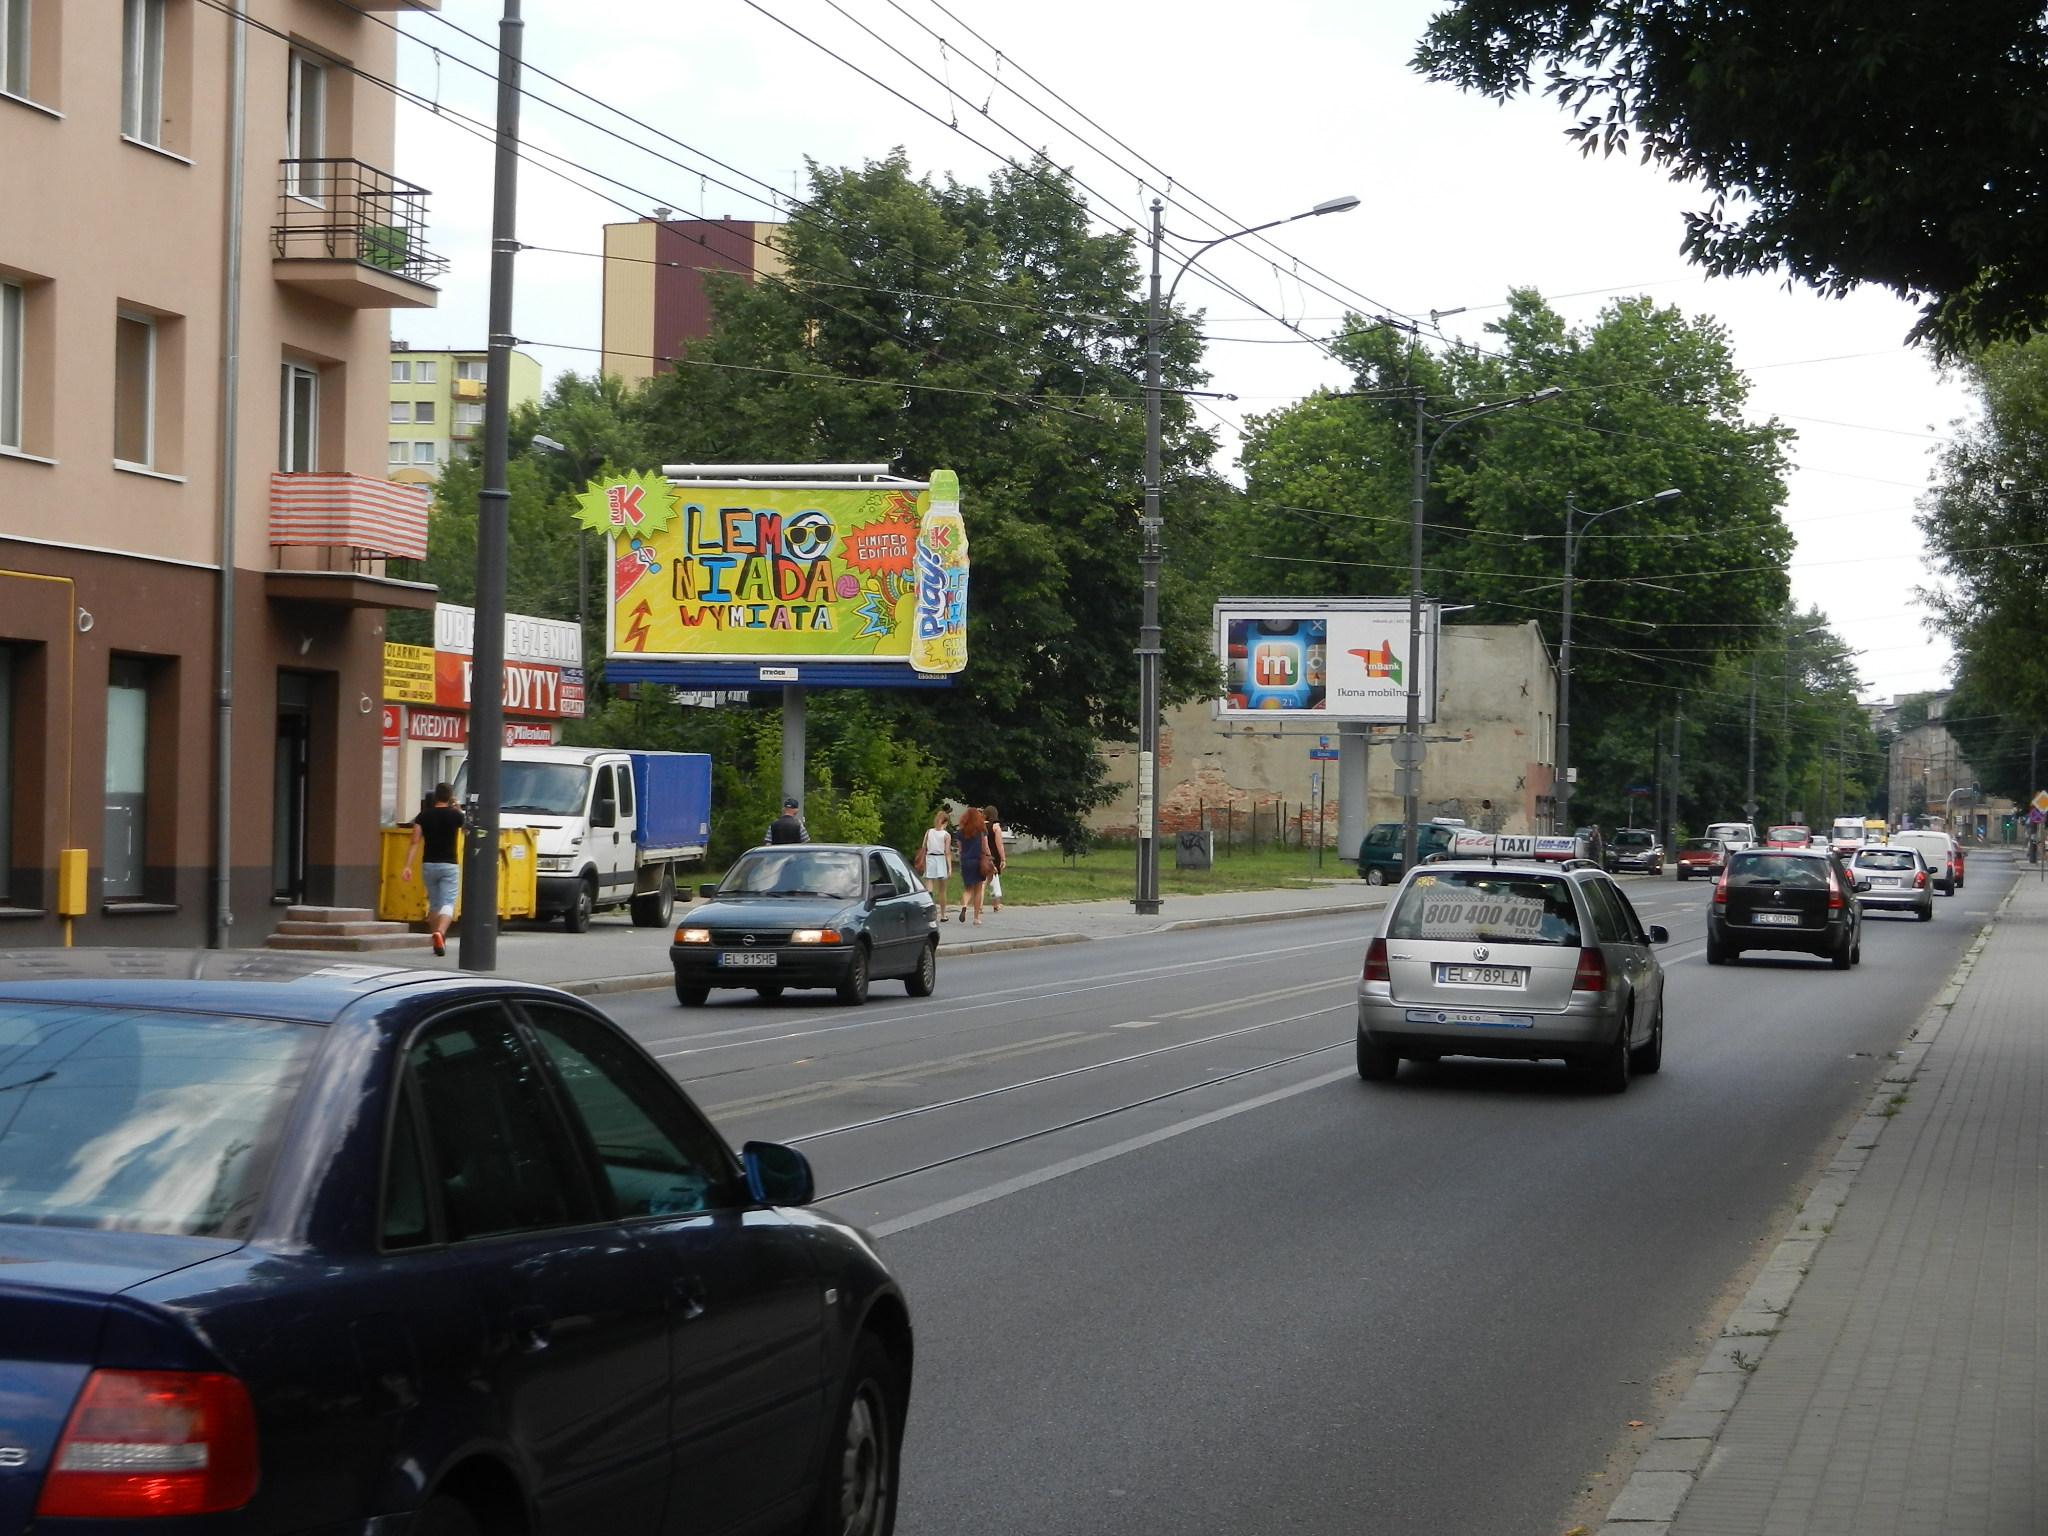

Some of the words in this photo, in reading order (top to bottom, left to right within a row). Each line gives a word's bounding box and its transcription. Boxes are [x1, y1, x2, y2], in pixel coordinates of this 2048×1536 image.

[857, 534, 907, 547] LIMITED
[858, 546, 908, 560] EDITION
[672, 555, 838, 602] NIADA
[679, 604, 832, 631] WYMIATA
[440, 608, 578, 663] UBEECZENIA
[1261, 655, 1294, 675] m
[1368, 663, 1401, 671] mBank
[1337, 687, 1365, 697] Ikona
[1367, 687, 1422, 697] mobilnoi
[412, 714, 461, 738] KREDYTY
[1501, 837, 1531, 852] TAXI
[1425, 904, 1463, 924] 800
[1464, 904, 1502, 925] 400
[1503, 906, 1542, 928] 400
[724, 954, 739, 965] EL
[743, 954, 776, 965] 815HE
[1448, 967, 1468, 982] EL
[1473, 968, 1520, 985] 789LA
